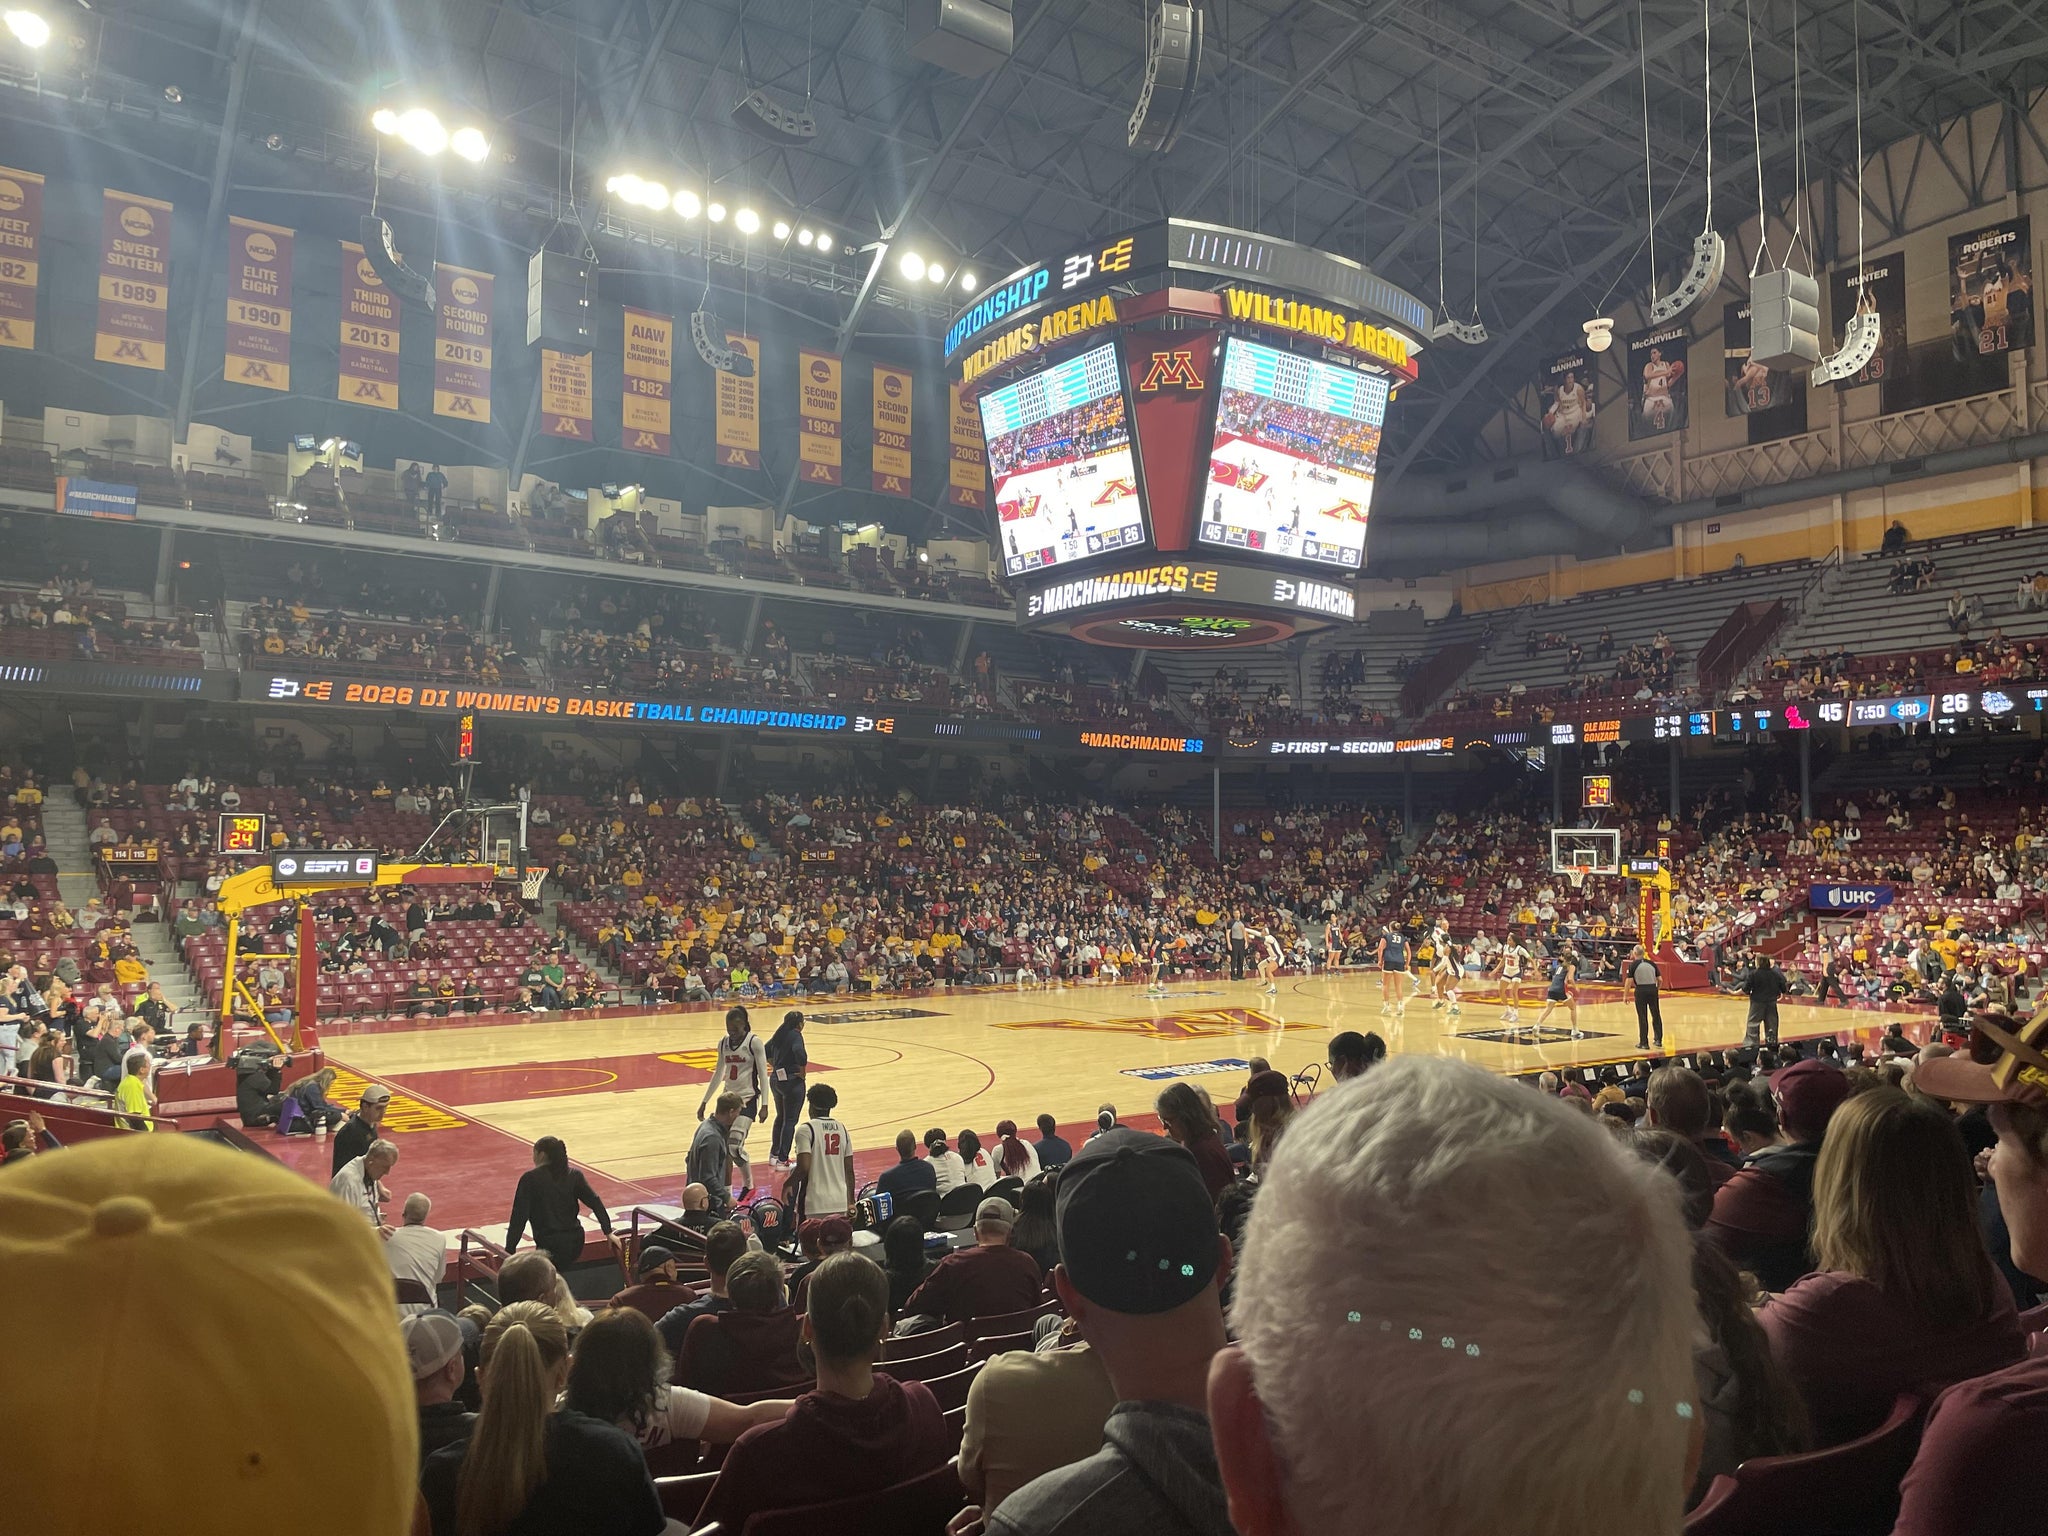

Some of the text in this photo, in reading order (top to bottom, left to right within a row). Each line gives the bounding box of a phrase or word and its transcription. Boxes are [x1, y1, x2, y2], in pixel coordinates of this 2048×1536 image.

[1963, 231, 2017, 254] ROBERTS
[1978, 229, 2000, 241] LINDA
[112, 239, 160, 259] SWEET
[107, 252, 163, 274] SIXTEEN
[243, 265, 278, 283] ELITE
[1847, 268, 1888, 288] HUNTER
[112, 281, 157, 304] 1989
[242, 279, 279, 297] EIGHT
[353, 288, 390, 306] THIRD
[454, 287, 479, 299] NCAA
[238, 305, 281, 327] 1990
[351, 301, 392, 319] ROUND
[443, 305, 488, 324] SECOND
[446, 317, 484, 336] ROUND
[631, 324, 666, 343] AIAW
[1226, 288, 1408, 367] WILLIAMS ARENA
[350, 327, 390, 348] 2013
[962, 323, 1039, 384] WILLIAMS
[1039, 295, 1117, 345] ARENA
[1631, 328, 1683, 351] McCARVILLE
[1979, 325, 2008, 354] 21
[445, 344, 483, 363] 2019
[630, 343, 666, 357] REGION VI
[350, 361, 389, 374] BASKETBALL
[626, 352, 670, 367] CHAMPIONS
[1551, 358, 1584, 374] BANHAM
[1140, 351, 1204, 391] M
[1859, 358, 1885, 382] 13
[631, 378, 664, 397] 1982
[804, 385, 837, 401] SECOND
[1747, 384, 1771, 409] 13
[807, 397, 835, 411] ROUND
[877, 400, 908, 415] SECOND
[807, 418, 835, 435] 1994
[879, 411, 906, 425] ROUND
[956, 416, 980, 429] SWEET
[1653, 410, 1665, 430] 4
[879, 431, 905, 448] 2002
[1564, 434, 1574, 453] 1
[955, 446, 980, 461] 2003
[69, 491, 136, 504] #MARCHMADNESS
[1125, 528, 1139, 542] 26
[1206, 525, 1221, 541] 45
[1276, 534, 1293, 546] 7:50
[1010, 557, 1023, 571] 45
[1342, 548, 1356, 563] 26
[1043, 565, 1190, 615] MARCHMADNESS
[2027, 690, 2048, 699] FOULS
[345, 683, 847, 731] 2026 DI WOMEN'S BASKETBALL CHAMPIONSHIP
[1818, 693, 1969, 722] 45 7:50 3RD 26
[2034, 698, 2043, 711] 1
[1551, 724, 1573, 735] FIELD
[1583, 722, 1598, 733] OLE
[1599, 720, 1621, 731] MISS
[1688, 714, 1710, 724] 40%
[1759, 718, 1767, 730] 0
[1080, 731, 1204, 754] #MARCHMADNESS
[1552, 734, 1575, 745] GOALS
[1583, 731, 1620, 743] GONZAGA
[1689, 725, 1710, 735] 32%
[1286, 740, 1328, 754] FIRST
[1342, 740, 1395, 754] SECOND
[1395, 737, 1442, 753] ROUNDS
[1592, 778, 1609, 789] 7:50
[1589, 788, 1608, 804] 24
[232, 817, 260, 833] 7:50
[229, 832, 254, 848] 24
[115, 850, 146, 859] 114 115
[280, 862, 296, 870] abc
[302, 860, 350, 873] ESPN
[1842, 890, 1876, 904] UHC
[1391, 934, 1402, 944] 33
[824, 1133, 840, 1155] 12
[880, 1198, 889, 1220] FIRST
